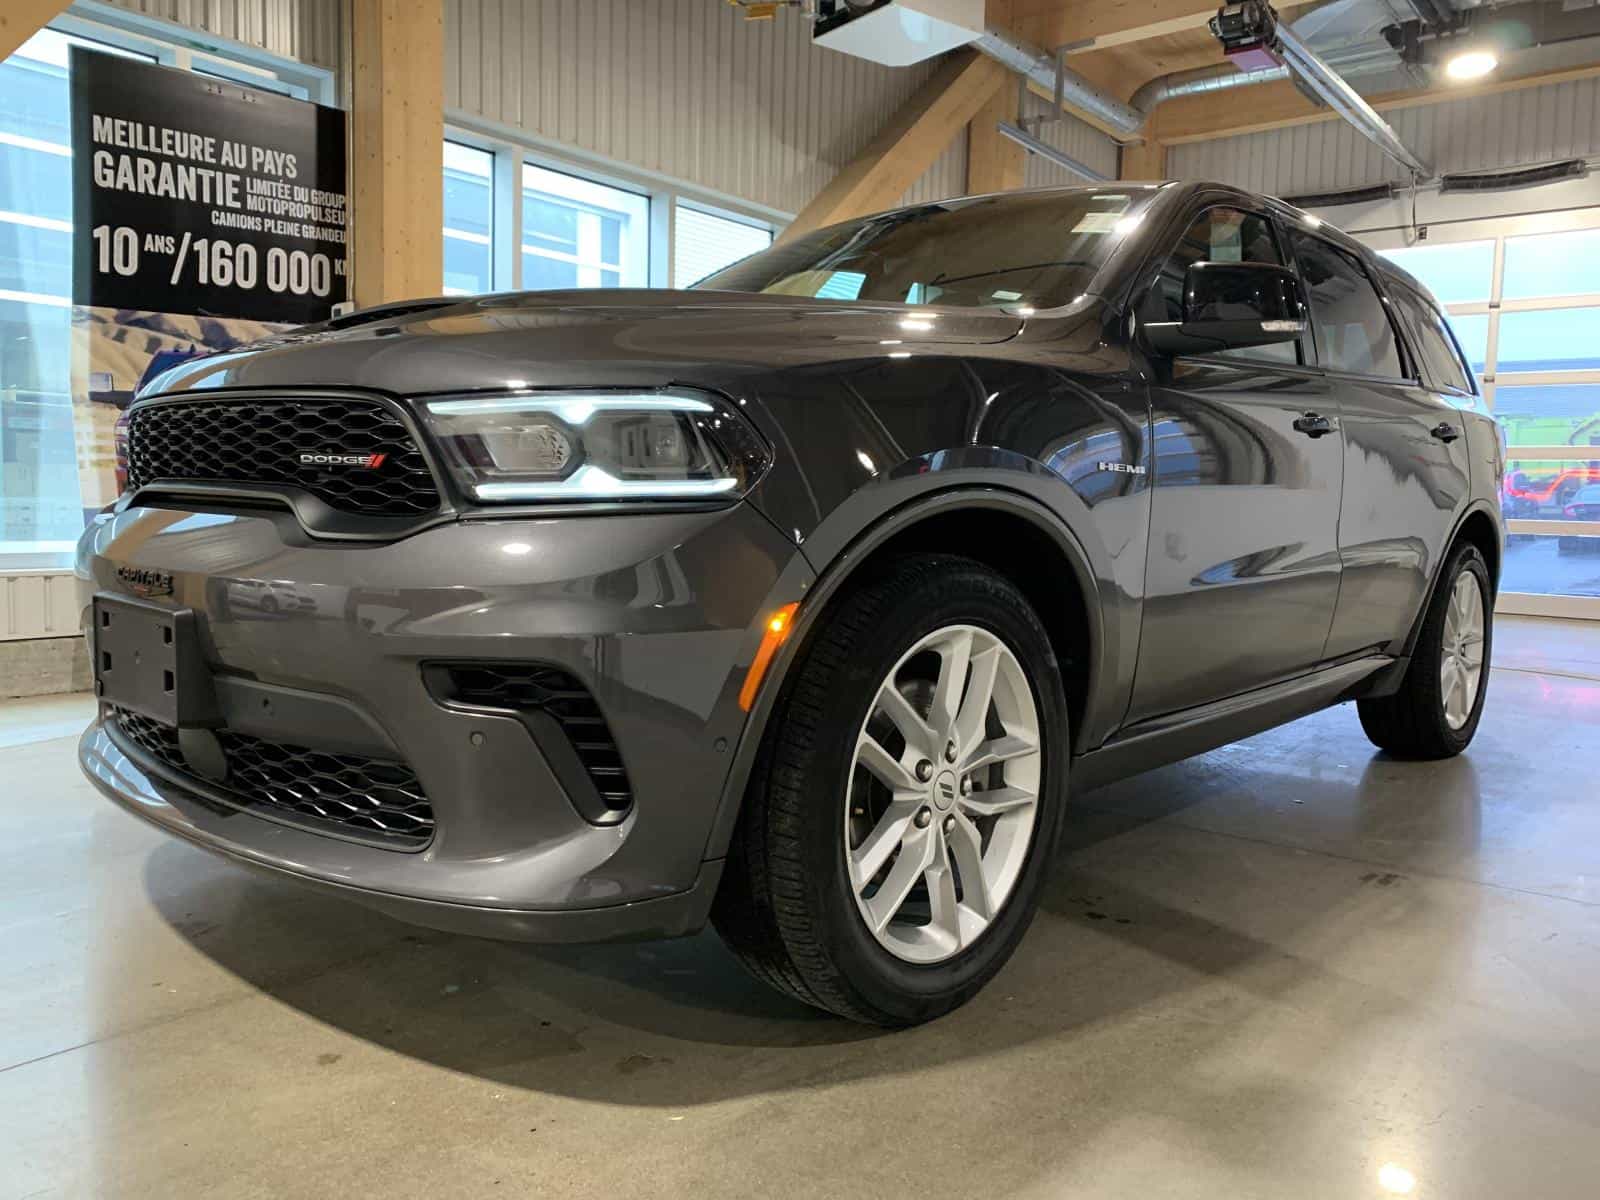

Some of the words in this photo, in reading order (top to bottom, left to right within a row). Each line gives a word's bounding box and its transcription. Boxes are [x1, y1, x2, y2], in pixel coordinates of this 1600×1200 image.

[93, 114, 216, 163] MEILLEURE
[221, 141, 247, 168] AU
[252, 147, 297, 178] PAYS
[93, 150, 241, 208] GARANTIE
[246, 177, 291, 200] LIMITÉE
[294, 185, 308, 202] DU
[211, 211, 261, 232] CAMIONS
[264, 219, 301, 237] PLEINE
[93, 225, 138, 277] 10
[266, 248, 331, 297] 000
[300, 454, 372, 465] DODGE
[1098, 461, 1146, 474] HEMI
